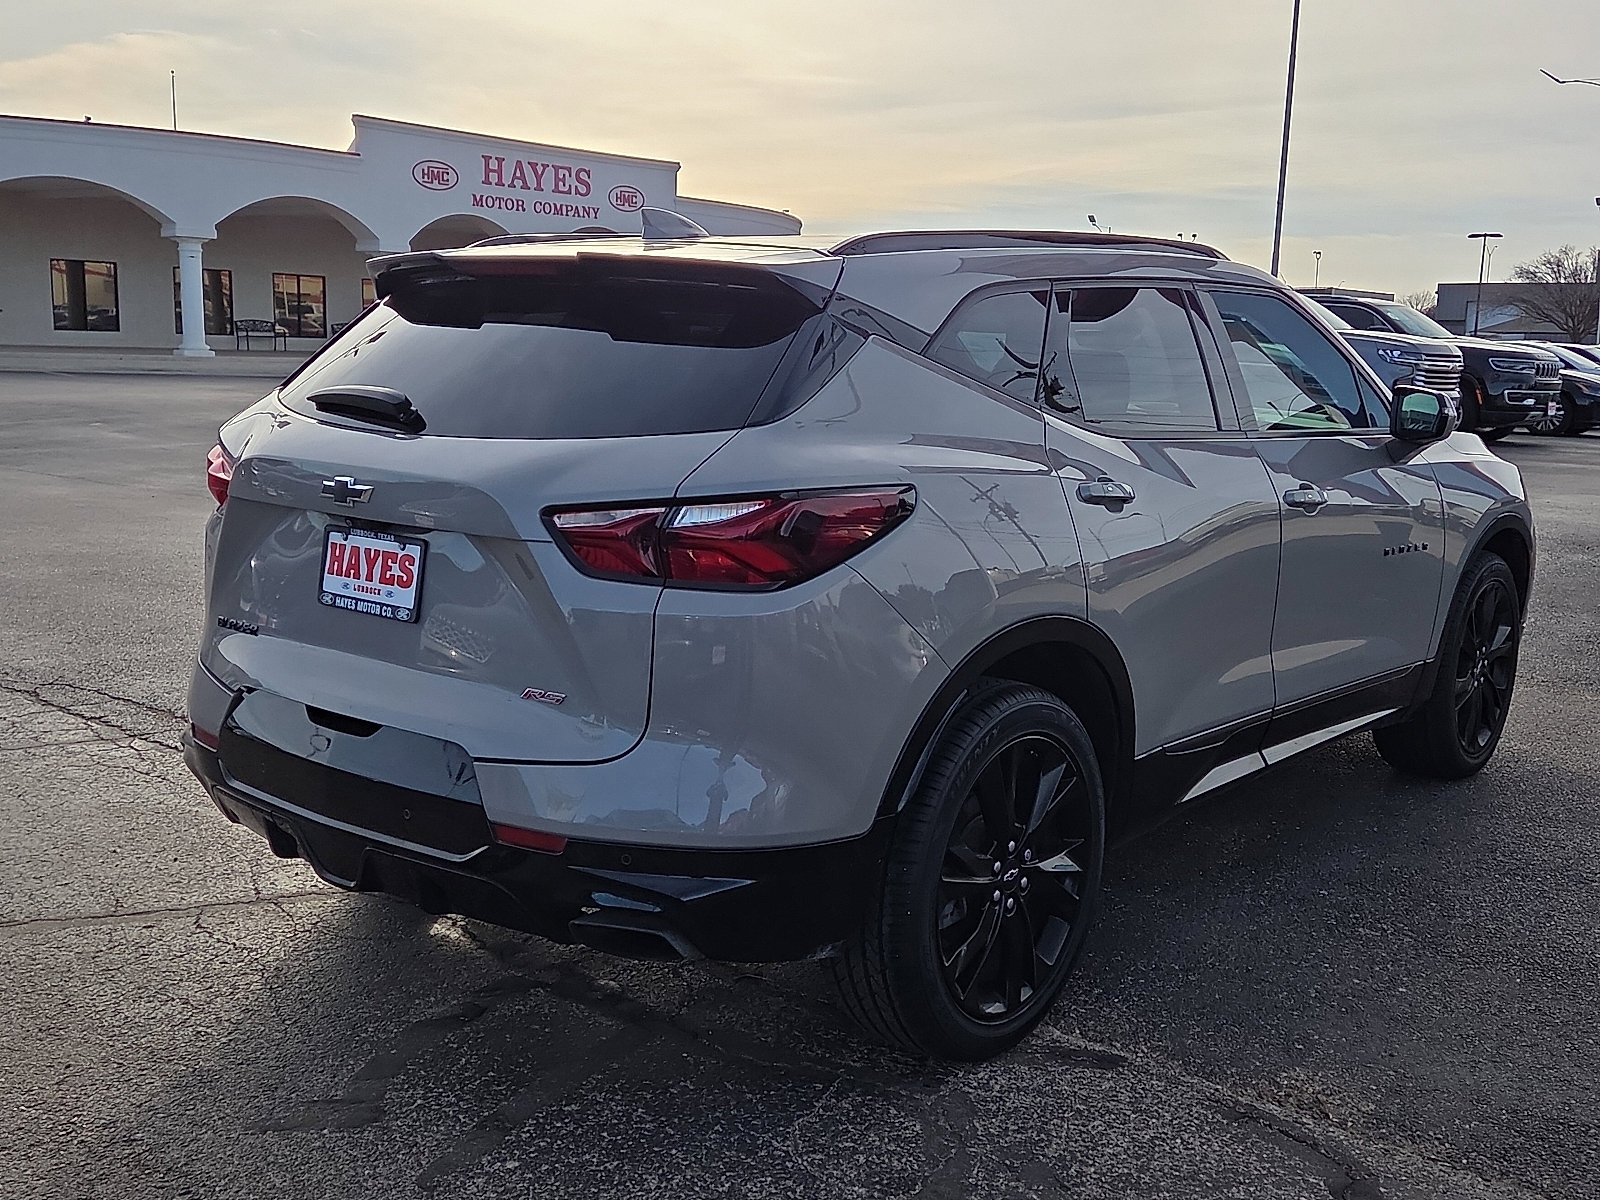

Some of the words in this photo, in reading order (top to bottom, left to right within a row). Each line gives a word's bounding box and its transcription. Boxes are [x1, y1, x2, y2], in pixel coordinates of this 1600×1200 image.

[421, 165, 450, 186] HMC
[481, 154, 592, 197] HAYES
[472, 193, 526, 212] MOTOR
[533, 200, 600, 219] COMPANY
[615, 190, 638, 208] HMC
[377, 532, 395, 541] TEXAS
[327, 541, 416, 589] HAYES
[353, 583, 382, 596] LUBBOCK
[335, 596, 356, 610] HAYES
[357, 600, 381, 615] MOTOR
[381, 605, 394, 618] CO.
[519, 686, 567, 705] RS
